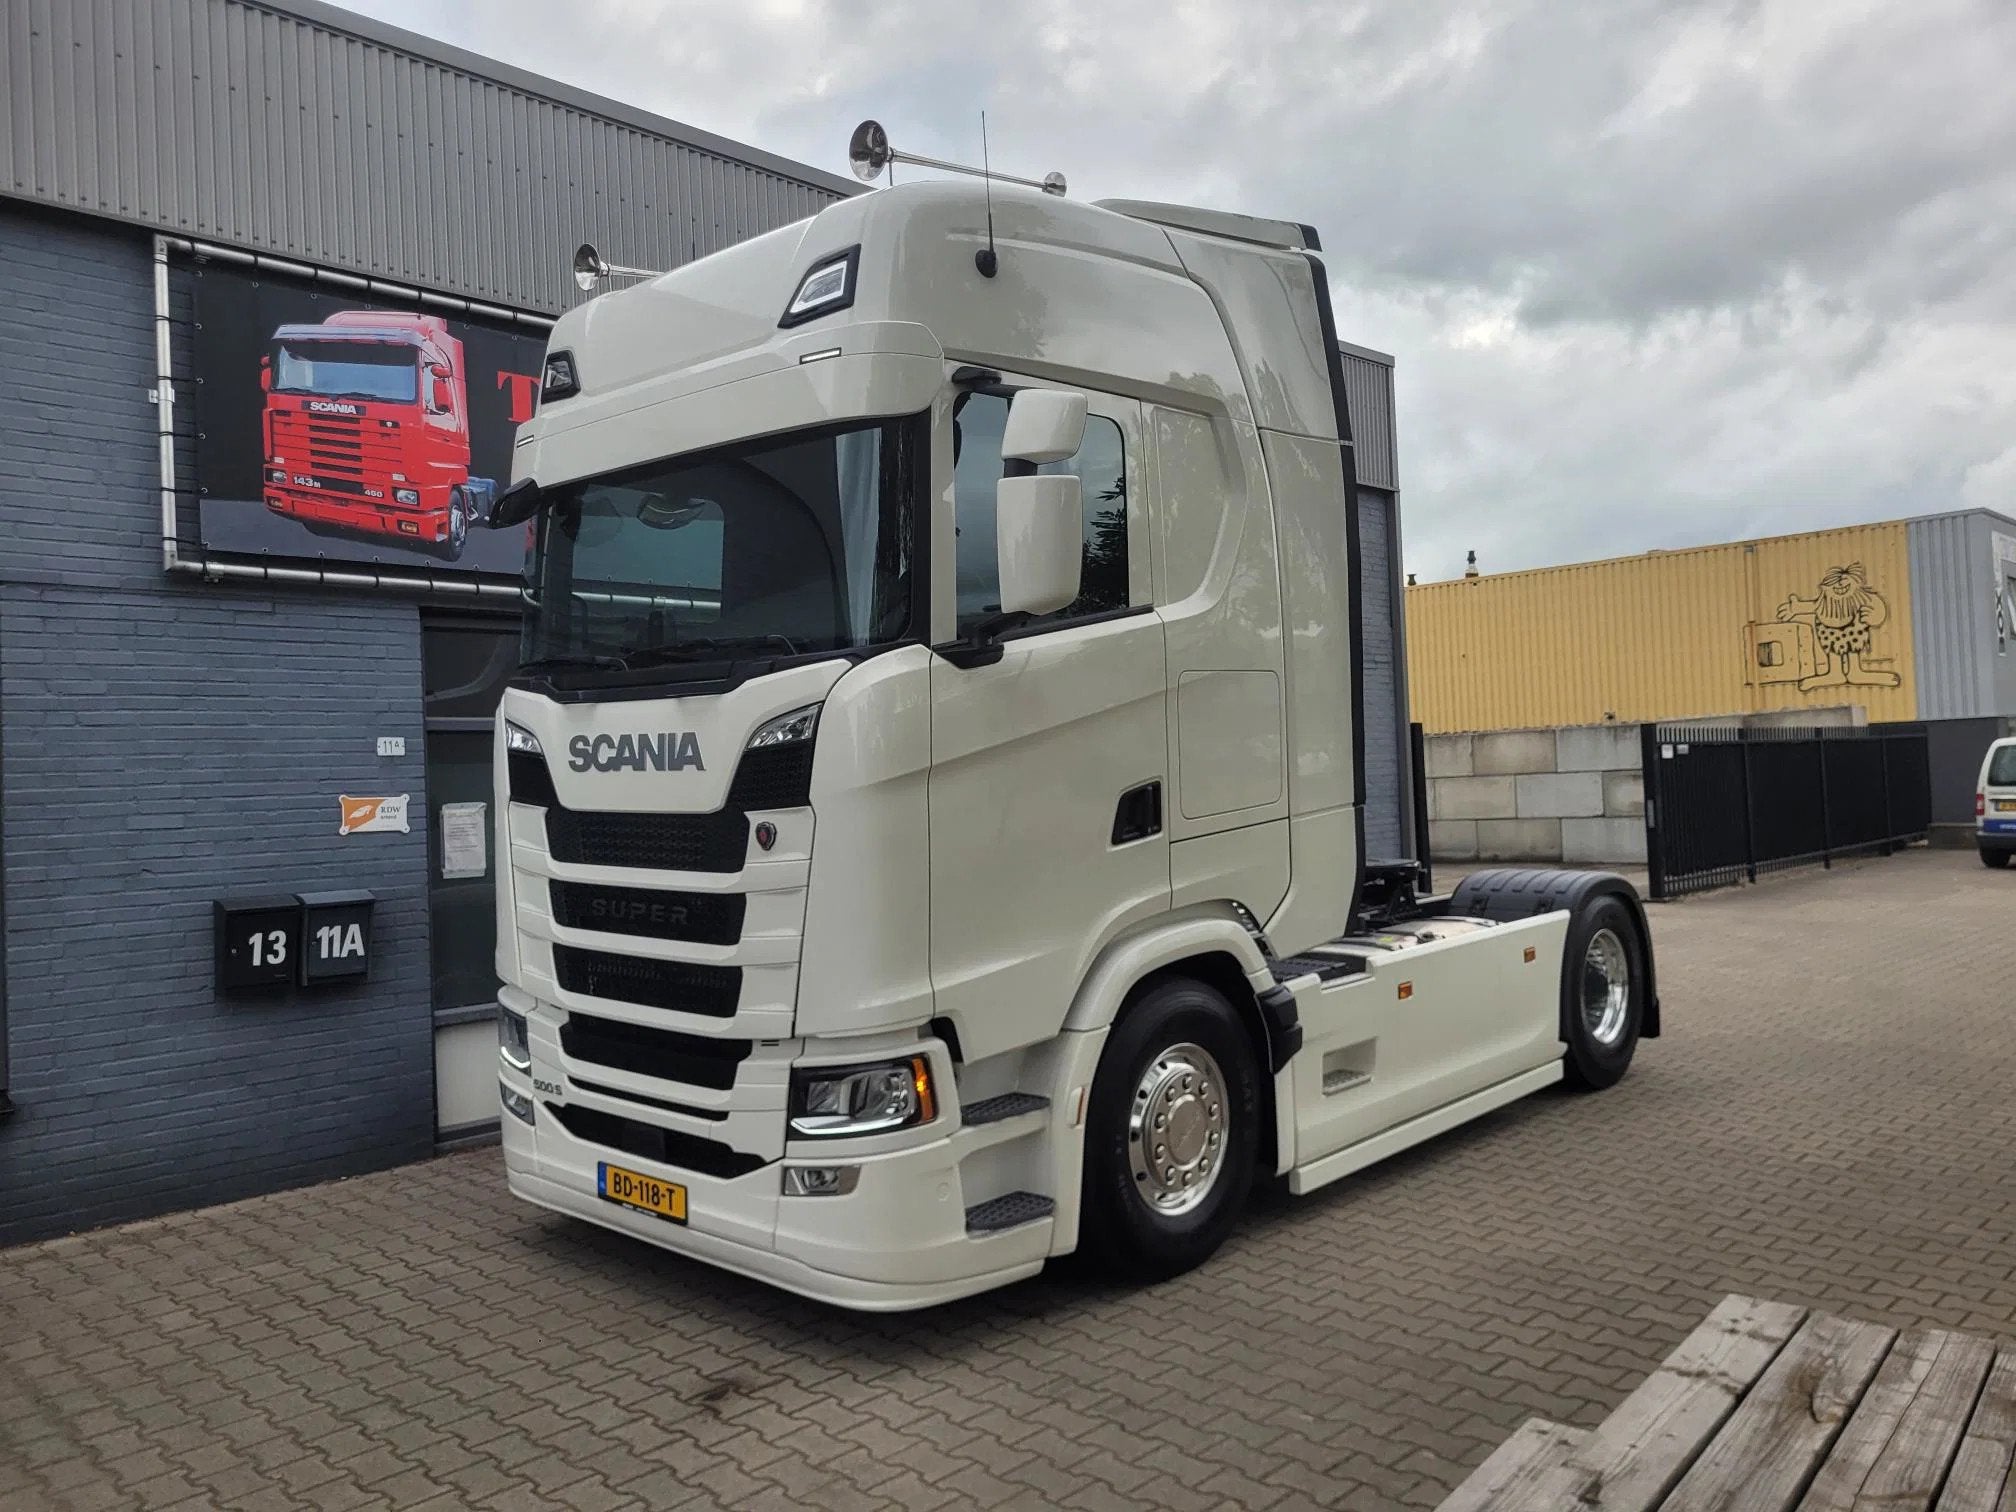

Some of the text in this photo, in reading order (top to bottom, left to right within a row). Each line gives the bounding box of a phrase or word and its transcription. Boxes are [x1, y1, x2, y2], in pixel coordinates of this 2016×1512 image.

[310, 401, 357, 415] SCANIA
[568, 731, 706, 773] SCANIA
[380, 806, 401, 814] RDW
[591, 898, 688, 925] SUPER
[248, 930, 287, 967] 13
[316, 923, 365, 959] 11A
[613, 1172, 676, 1211] BD-118-T
